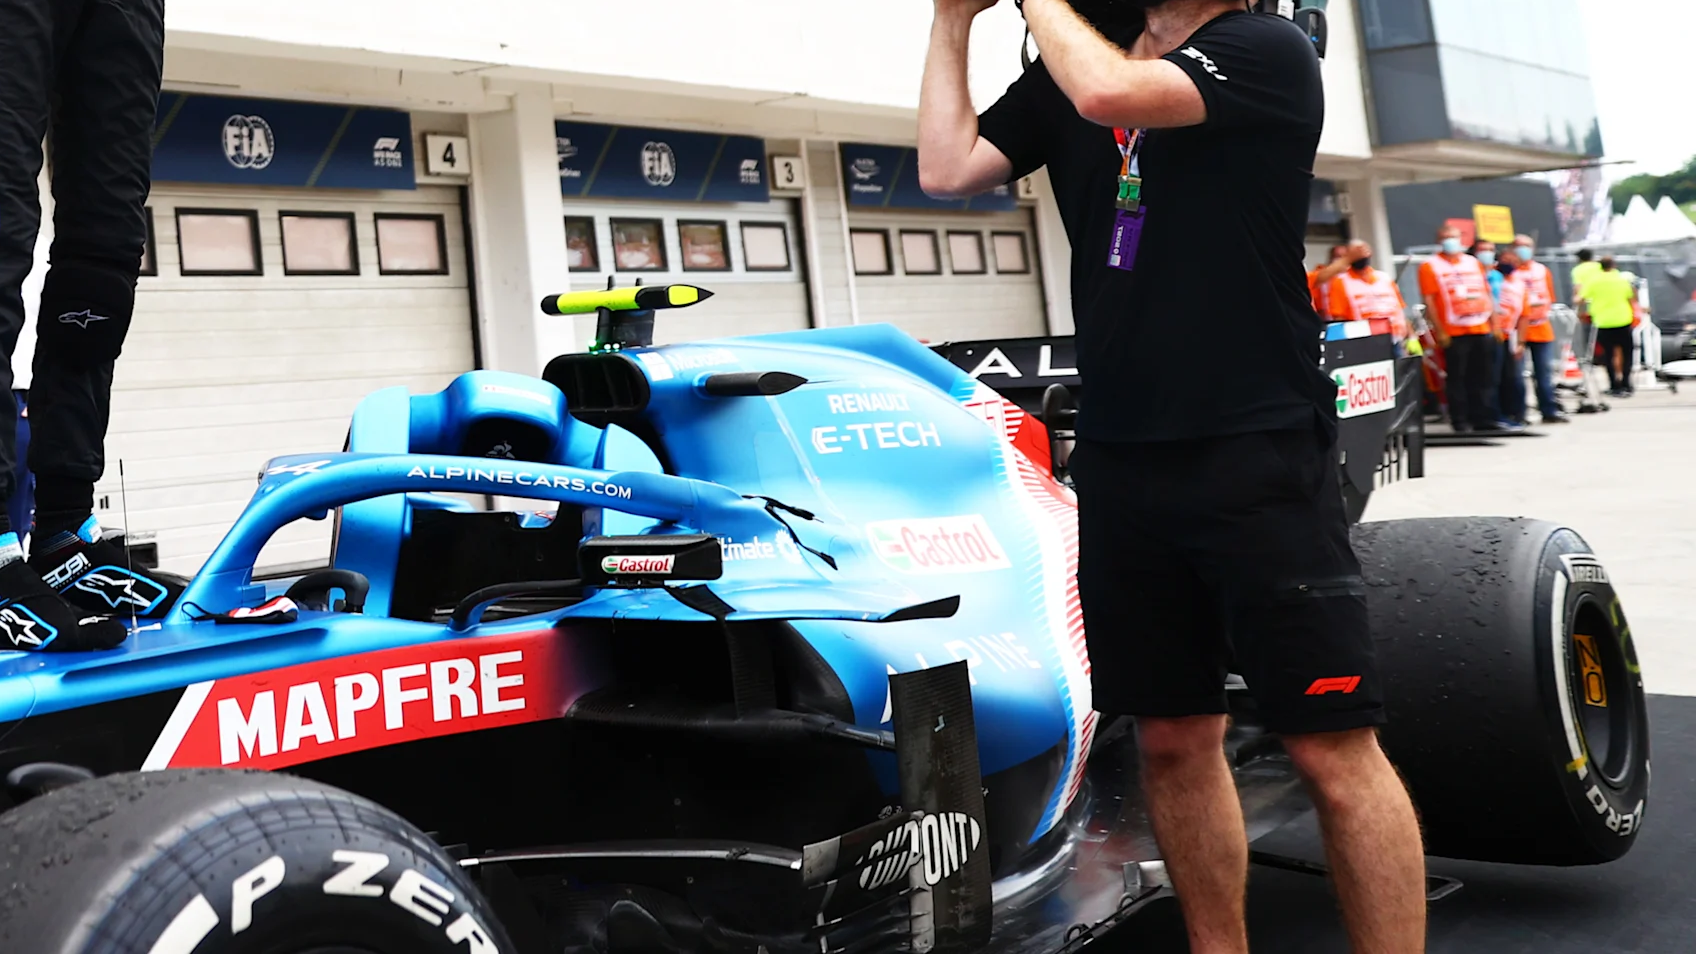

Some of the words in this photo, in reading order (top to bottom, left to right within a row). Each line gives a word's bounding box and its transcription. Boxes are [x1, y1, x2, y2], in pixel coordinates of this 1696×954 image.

[443, 142, 456, 168] 4
[785, 162, 794, 183] 3
[1024, 176, 1033, 194] 2
[1349, 367, 1394, 409] Castrol
[827, 393, 911, 414] RENAULT
[812, 422, 941, 454] E-TECH
[407, 465, 632, 499] ALPINECARS.COM
[718, 536, 777, 561] timate
[901, 523, 1000, 568] Castrol
[619, 557, 670, 572] Castrol
[216, 650, 526, 766] MAPFRE
[232, 855, 286, 934] P
[323, 849, 501, 954] ZER
